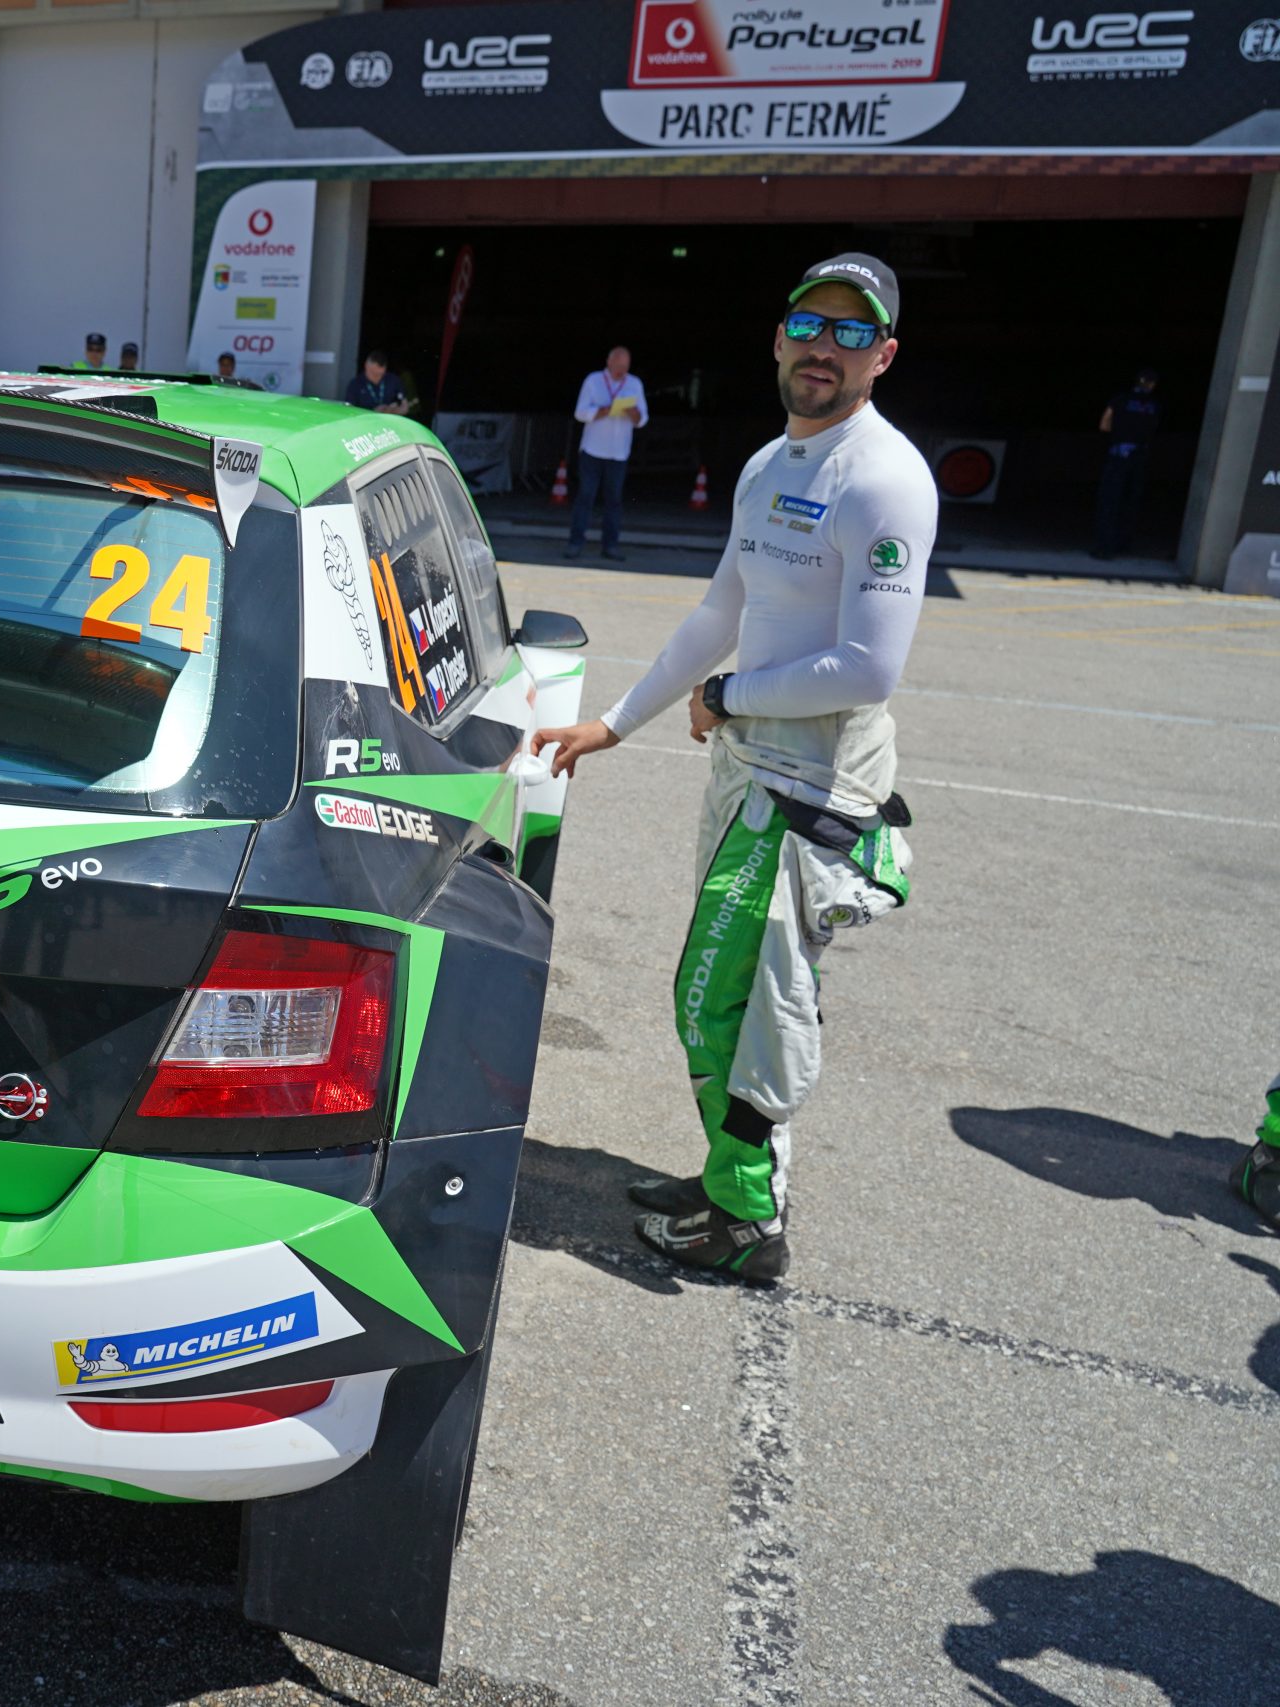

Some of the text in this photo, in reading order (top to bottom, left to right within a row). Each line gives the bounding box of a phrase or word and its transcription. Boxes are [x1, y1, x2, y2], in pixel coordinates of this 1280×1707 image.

[732, 8, 803, 24] rally de
[1031, 10, 1195, 50] WRC
[423, 34, 552, 69] WRC
[727, 19, 926, 54] Portugal
[349, 58, 389, 81] FIA
[647, 51, 708, 65] vodafone
[891, 58, 923, 69] 2019
[659, 92, 892, 139] PARC FERMÉ
[223, 241, 296, 257] vodafone
[233, 335, 275, 356] acp
[215, 441, 260, 476] ŠKODA
[761, 541, 823, 568] Motorsport
[81, 544, 212, 654] 24
[370, 551, 426, 715] 24
[325, 738, 401, 775] R5 evo
[333, 802, 440, 845] Castrol EDGE
[40, 856, 104, 890] evo
[684, 837, 773, 1048] ŠKODA Motorsport
[131, 1311, 298, 1367] MICHELIN
